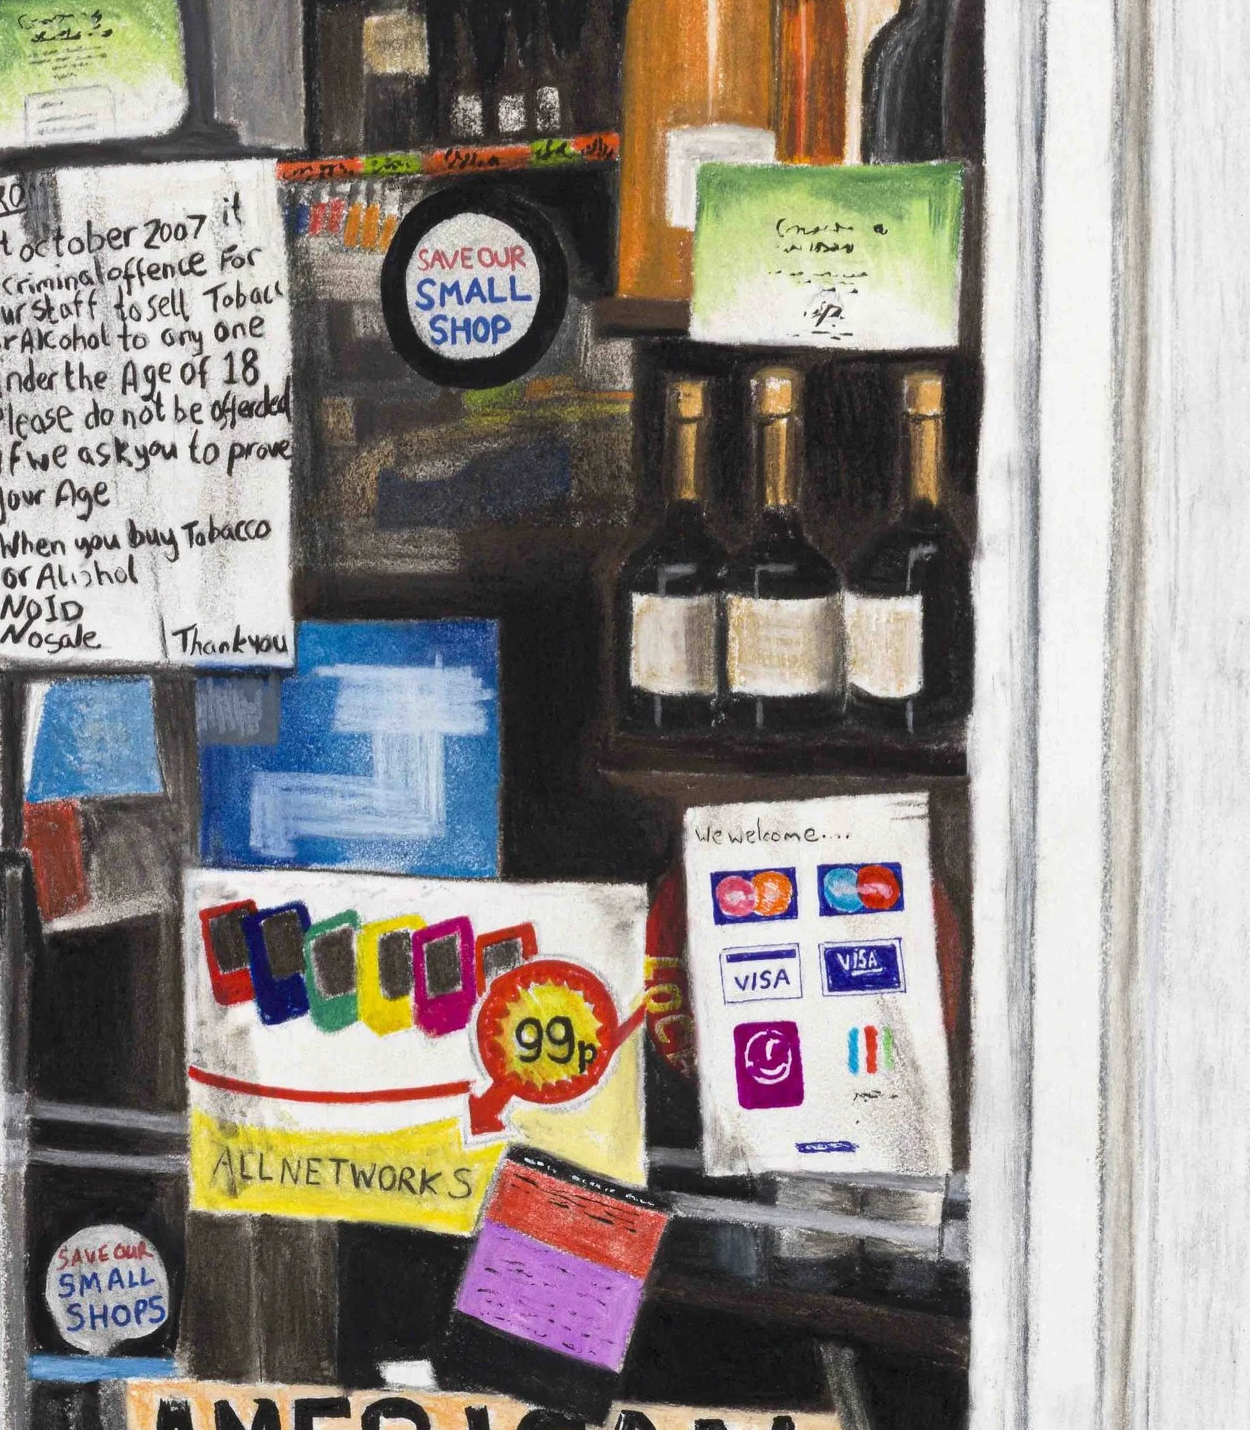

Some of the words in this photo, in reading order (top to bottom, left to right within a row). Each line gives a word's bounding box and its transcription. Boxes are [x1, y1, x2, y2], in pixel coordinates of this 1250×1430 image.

[144, 214, 207, 250] 2007
[2, 256, 105, 295] criminal
[417, 247, 474, 272] SAVE
[477, 244, 527, 271] OUR
[114, 285, 142, 322] to
[415, 275, 532, 312] SMALL
[117, 321, 147, 352] to
[429, 314, 512, 346] SHOP
[65, 359, 108, 393] the
[121, 360, 172, 403] Age
[180, 355, 212, 389] of
[223, 347, 260, 386] 18
[85, 398, 114, 430] do
[122, 391, 166, 430] not
[174, 394, 202, 424] be
[26, 443, 68, 472] we
[77, 435, 133, 467] ask
[134, 441, 178, 471] you
[189, 429, 220, 465] to
[227, 439, 293, 477] prove
[55, 478, 110, 522] Age
[74, 531, 121, 559] you
[128, 518, 180, 563] buy
[181, 514, 272, 549] Tobacco
[2, 564, 32, 589] or
[836, 947, 880, 974] VISA
[734, 968, 791, 992] VISA
[514, 1015, 597, 1074] 99p
[56, 1243, 110, 1271] SAVE
[113, 1240, 154, 1261] OUR
[58, 1266, 156, 1299] SMALL
[66, 1295, 166, 1332] SHOPS
